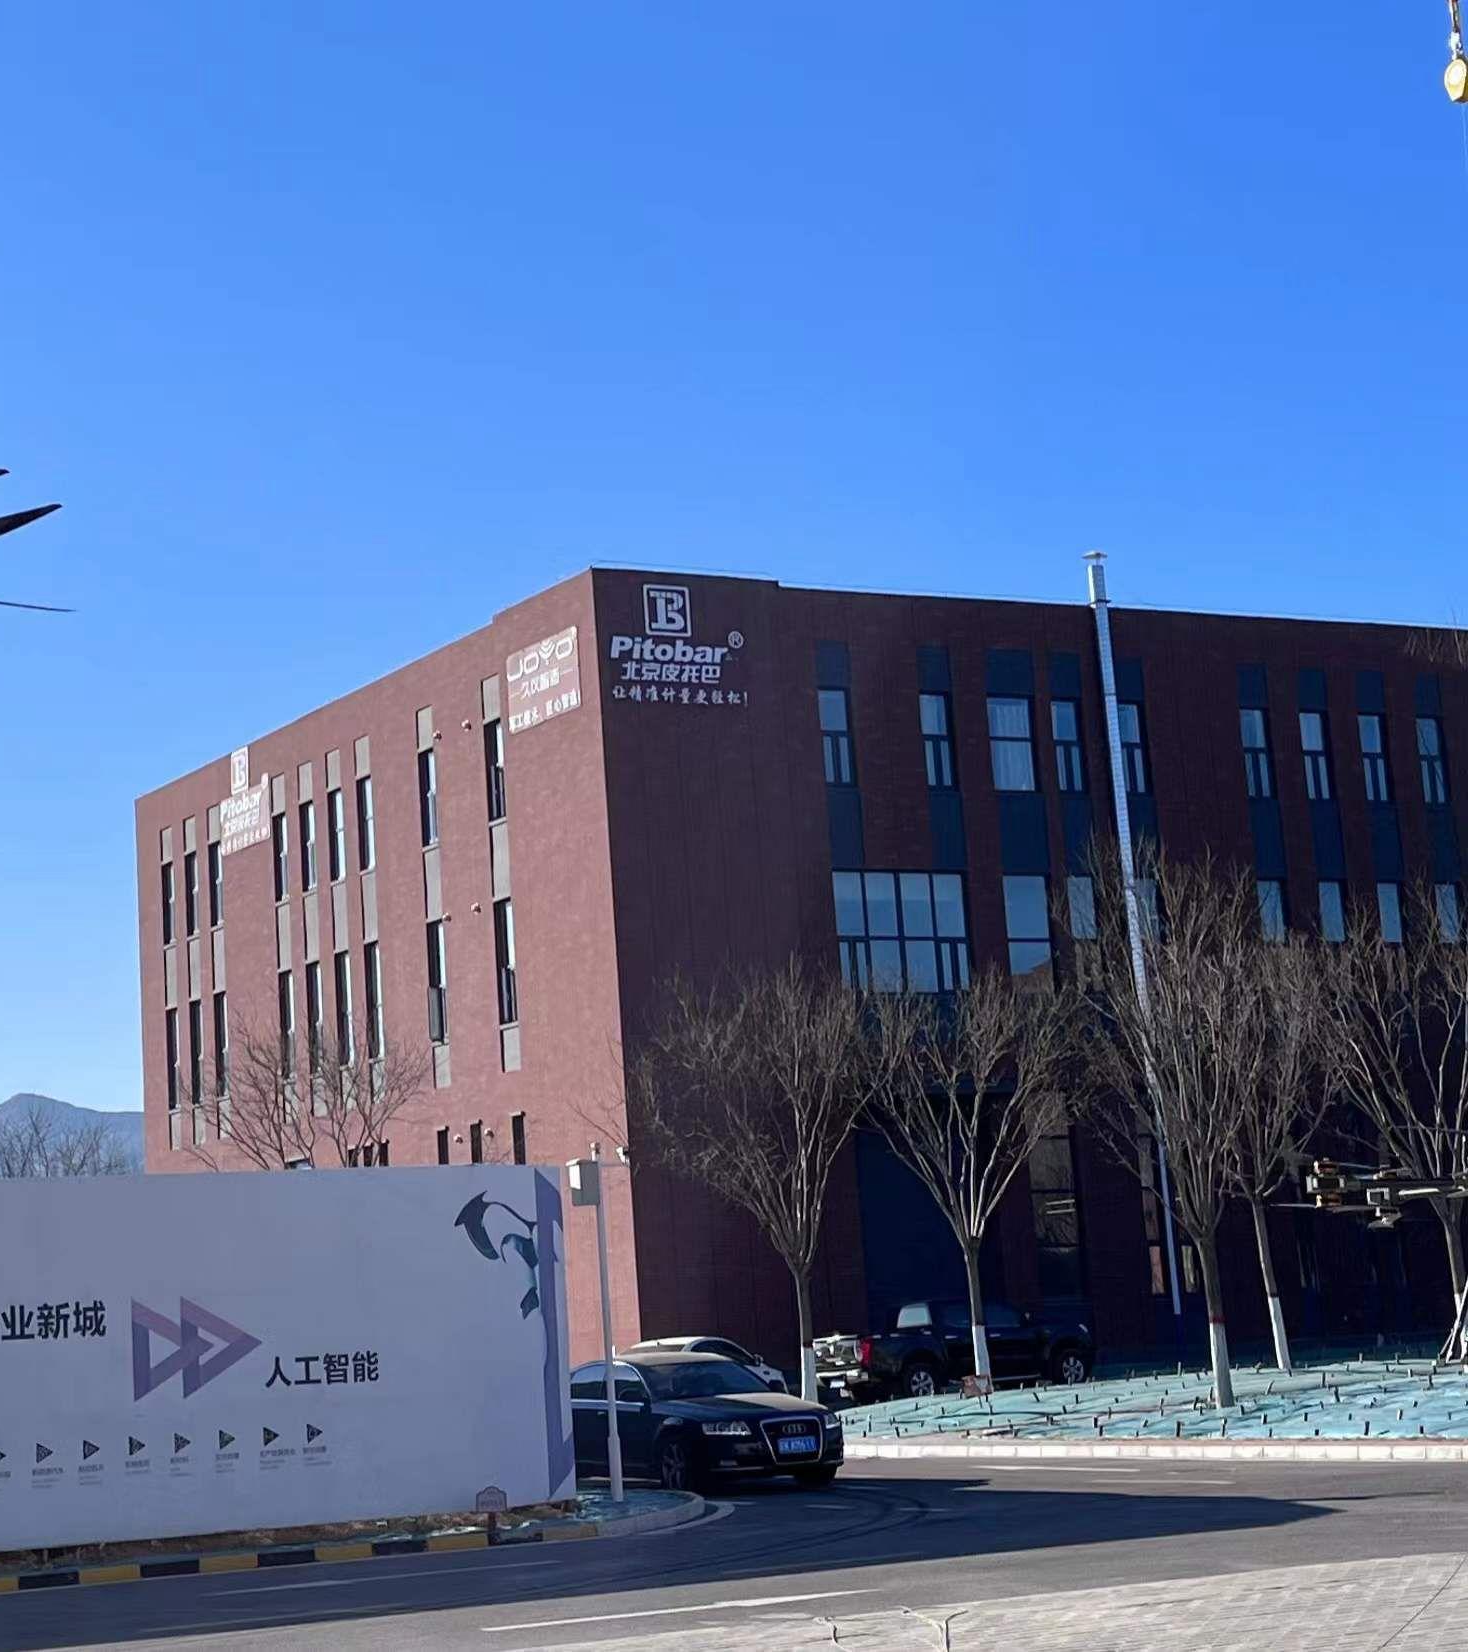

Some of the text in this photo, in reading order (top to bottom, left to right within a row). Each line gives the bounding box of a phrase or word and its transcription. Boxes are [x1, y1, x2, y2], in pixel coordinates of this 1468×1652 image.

[610, 635, 729, 664] Pitobar
[620, 661, 721, 684] 北京皮托巴
[265, 1350, 380, 1388] 人工智能
